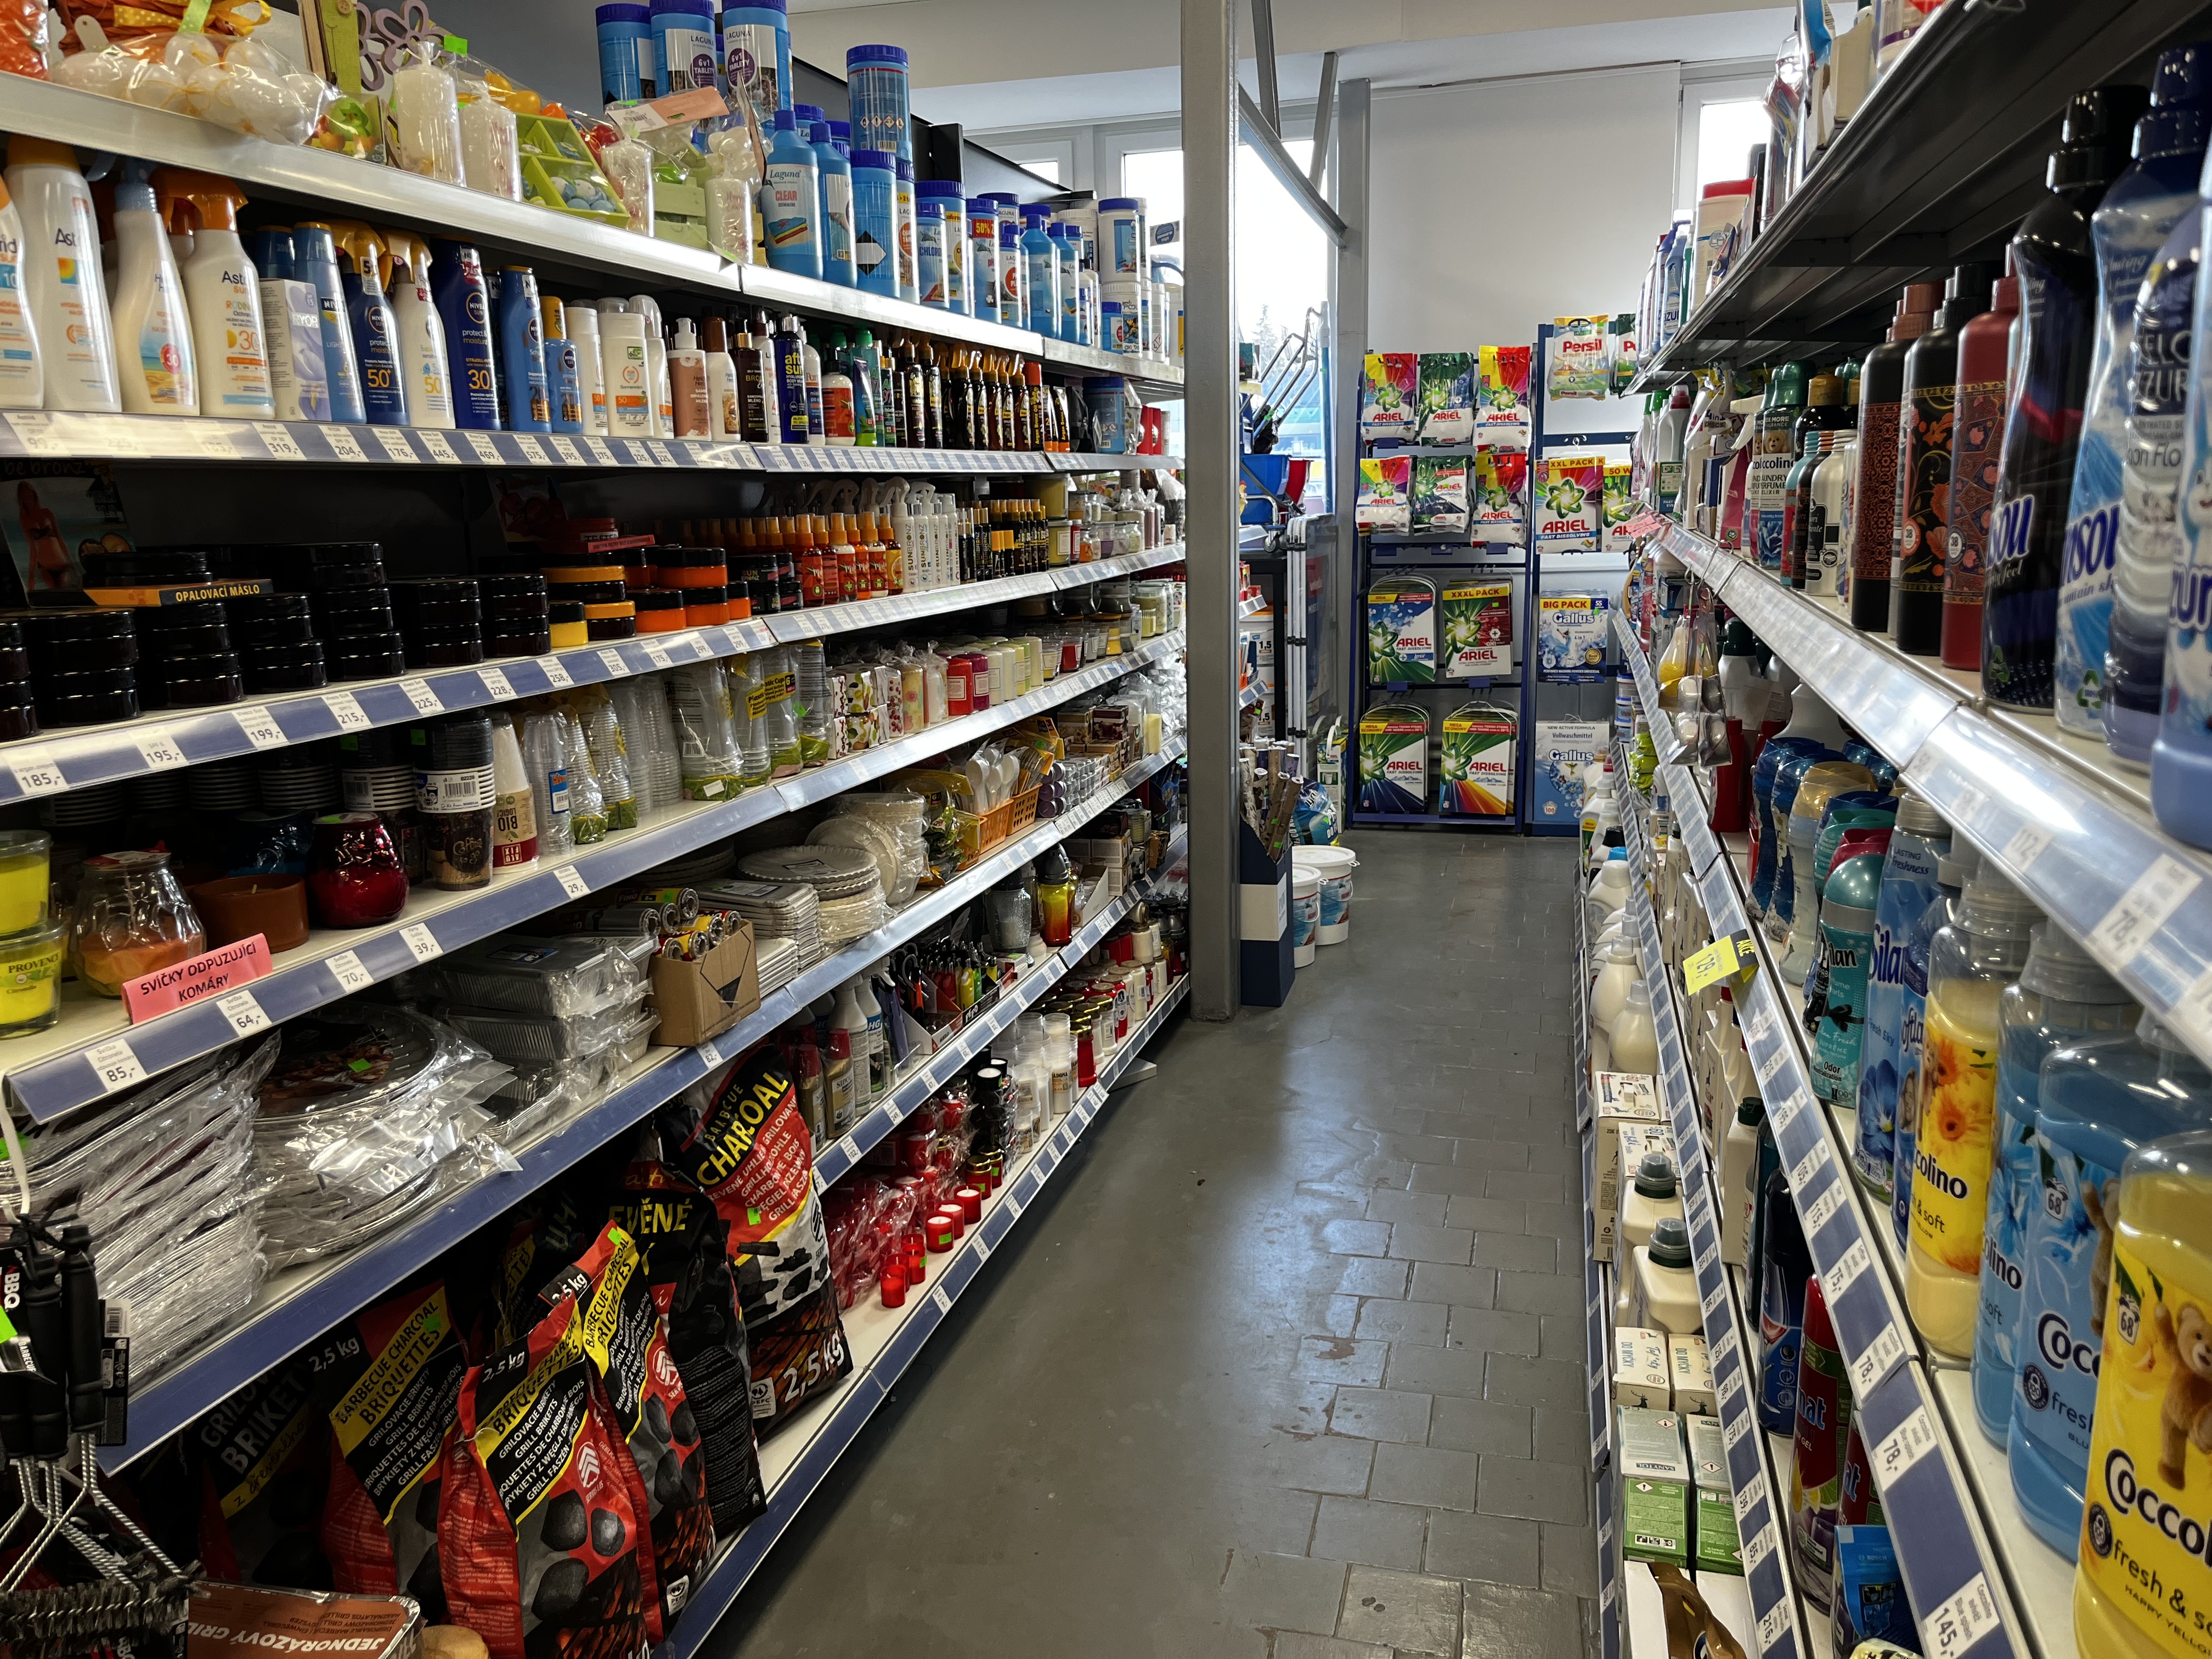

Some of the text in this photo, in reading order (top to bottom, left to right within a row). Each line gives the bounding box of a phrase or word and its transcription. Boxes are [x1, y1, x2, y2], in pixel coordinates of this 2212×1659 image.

[726, 30, 751, 40] LAGUNA
[770, 170, 800, 179] Laguna
[775, 191, 798, 201] CLEAR
[977, 223, 990, 234] 50%
[292, 313, 318, 326] RYOR
[1563, 339, 1602, 352] Persil
[166, 352, 179, 366] 30
[468, 369, 490, 389] 30
[1373, 413, 1404, 421] ARIEL
[1433, 412, 1461, 420] ARIEL
[1486, 413, 1520, 421] ARIEL
[268, 443, 299, 454] 319,-
[336, 445, 362, 458] 204,-
[388, 447, 413, 459] 176,-
[433, 449, 455, 460] 445,-
[479, 450, 500, 461] 469,-
[526, 451, 546, 461] 575,-
[562, 452, 581, 462] 395,-
[596, 452, 613, 460] 375,-
[1570, 458, 1594, 466] PACK
[1481, 511, 1513, 520] ARIEL
[1542, 520, 1590, 533] ARIEL
[1904, 528, 1913, 538] 38
[905, 523, 913, 571] SUNBRONZ
[919, 523, 927, 568] SUNBRONZ
[1950, 537, 1959, 547] 38
[2005, 560, 2023, 580] feel
[176, 583, 260, 602] OPALOVACÍ MÁSLO
[1553, 612, 1594, 624] Gallus
[1397, 637, 1431, 646] ARIEL
[1459, 651, 1497, 661] ARIEL
[550, 673, 569, 683] 258,-
[786, 676, 791, 685] 6
[490, 685, 512, 695] 228,-
[415, 698, 437, 709] 225,-
[338, 712, 364, 724] 215,-
[250, 729, 280, 742] 199,-
[146, 751, 180, 764] 195,-
[1549, 749, 1594, 761] Gallus
[1386, 761, 1422, 770] ARIEL
[1469, 762, 1506, 772] ARIEL
[22, 774, 60, 787] 185,-
[498, 817, 518, 831] BIO
[1894, 849, 1921, 860] LASTING
[568, 883, 584, 893] 29,-
[618, 893, 637, 902] FINO
[415, 943, 435, 953] 39,-
[1736, 939, 1756, 957] AKCE
[1829, 943, 1857, 967] ilan
[141, 941, 257, 996] SVÍČKY ODPUZUJÍCÍ
[343, 971, 364, 984] 70,-
[179, 973, 229, 1002] KOMÁRY
[236, 1014, 260, 1028] 64,-
[868, 1020, 881, 1030] HG
[1883, 1030, 1895, 1046] Sky
[106, 1066, 135, 1082] 85,-
[1824, 1062, 1840, 1074] Odor
[783, 1138, 799, 1161] BOIS
[1796, 1161, 1807, 1186] 105,-
[2049, 1189, 2062, 1215] 68
[769, 1198, 794, 1221] GRILL
[1809, 1203, 1821, 1228] 115,-
[1923, 1209, 1945, 1235] soft
[1829, 1268, 1842, 1293] 75,-
[3, 1273, 21, 1309] BBQ
[585, 1238, 629, 1348] BARBECUE CHARCOAL
[2119, 1314, 2134, 1338] 68
[308, 1337, 359, 1372] 2,5 kg
[1622, 1350, 1634, 1368] MYČKY
[335, 1301, 439, 1425] BARBECUE CHARCOAL
[482, 1351, 525, 1383] 2,5 kg
[783, 1350, 822, 1403] 2,5
[823, 1330, 844, 1368] kg
[1678, 1356, 1691, 1374] MYČKY
[1857, 1356, 1872, 1384] 78,-
[369, 1368, 430, 1447] GRILOVACIE BRIKETY
[386, 1386, 433, 1445] GRILL BRIKETTS
[535, 1379, 584, 1457] DE CHARBON BOIS
[407, 1428, 419, 1441] DE
[499, 1408, 540, 1458] GRILOVACIE
[515, 1398, 558, 1458] GRILL BRIKETTS
[1726, 1423, 1735, 1446] 175,-
[537, 1435, 563, 1470] Z WĘGLA
[1883, 1439, 1899, 1472] 78,-
[374, 1456, 409, 1496] BRYKIETY
[408, 1448, 416, 1458] Z
[397, 1460, 422, 1486] GRILL
[526, 1475, 549, 1500] GRILL
[1738, 1492, 1748, 1515] 139,-
[1749, 1542, 1757, 1564] 85,-
[2113, 1539, 2186, 1618] fresh &
[2125, 1584, 2162, 1619] HAPPY
[1762, 1617, 1773, 1645] 216,-
[230, 1630, 385, 1653] JEDNORÁZOVÝ
